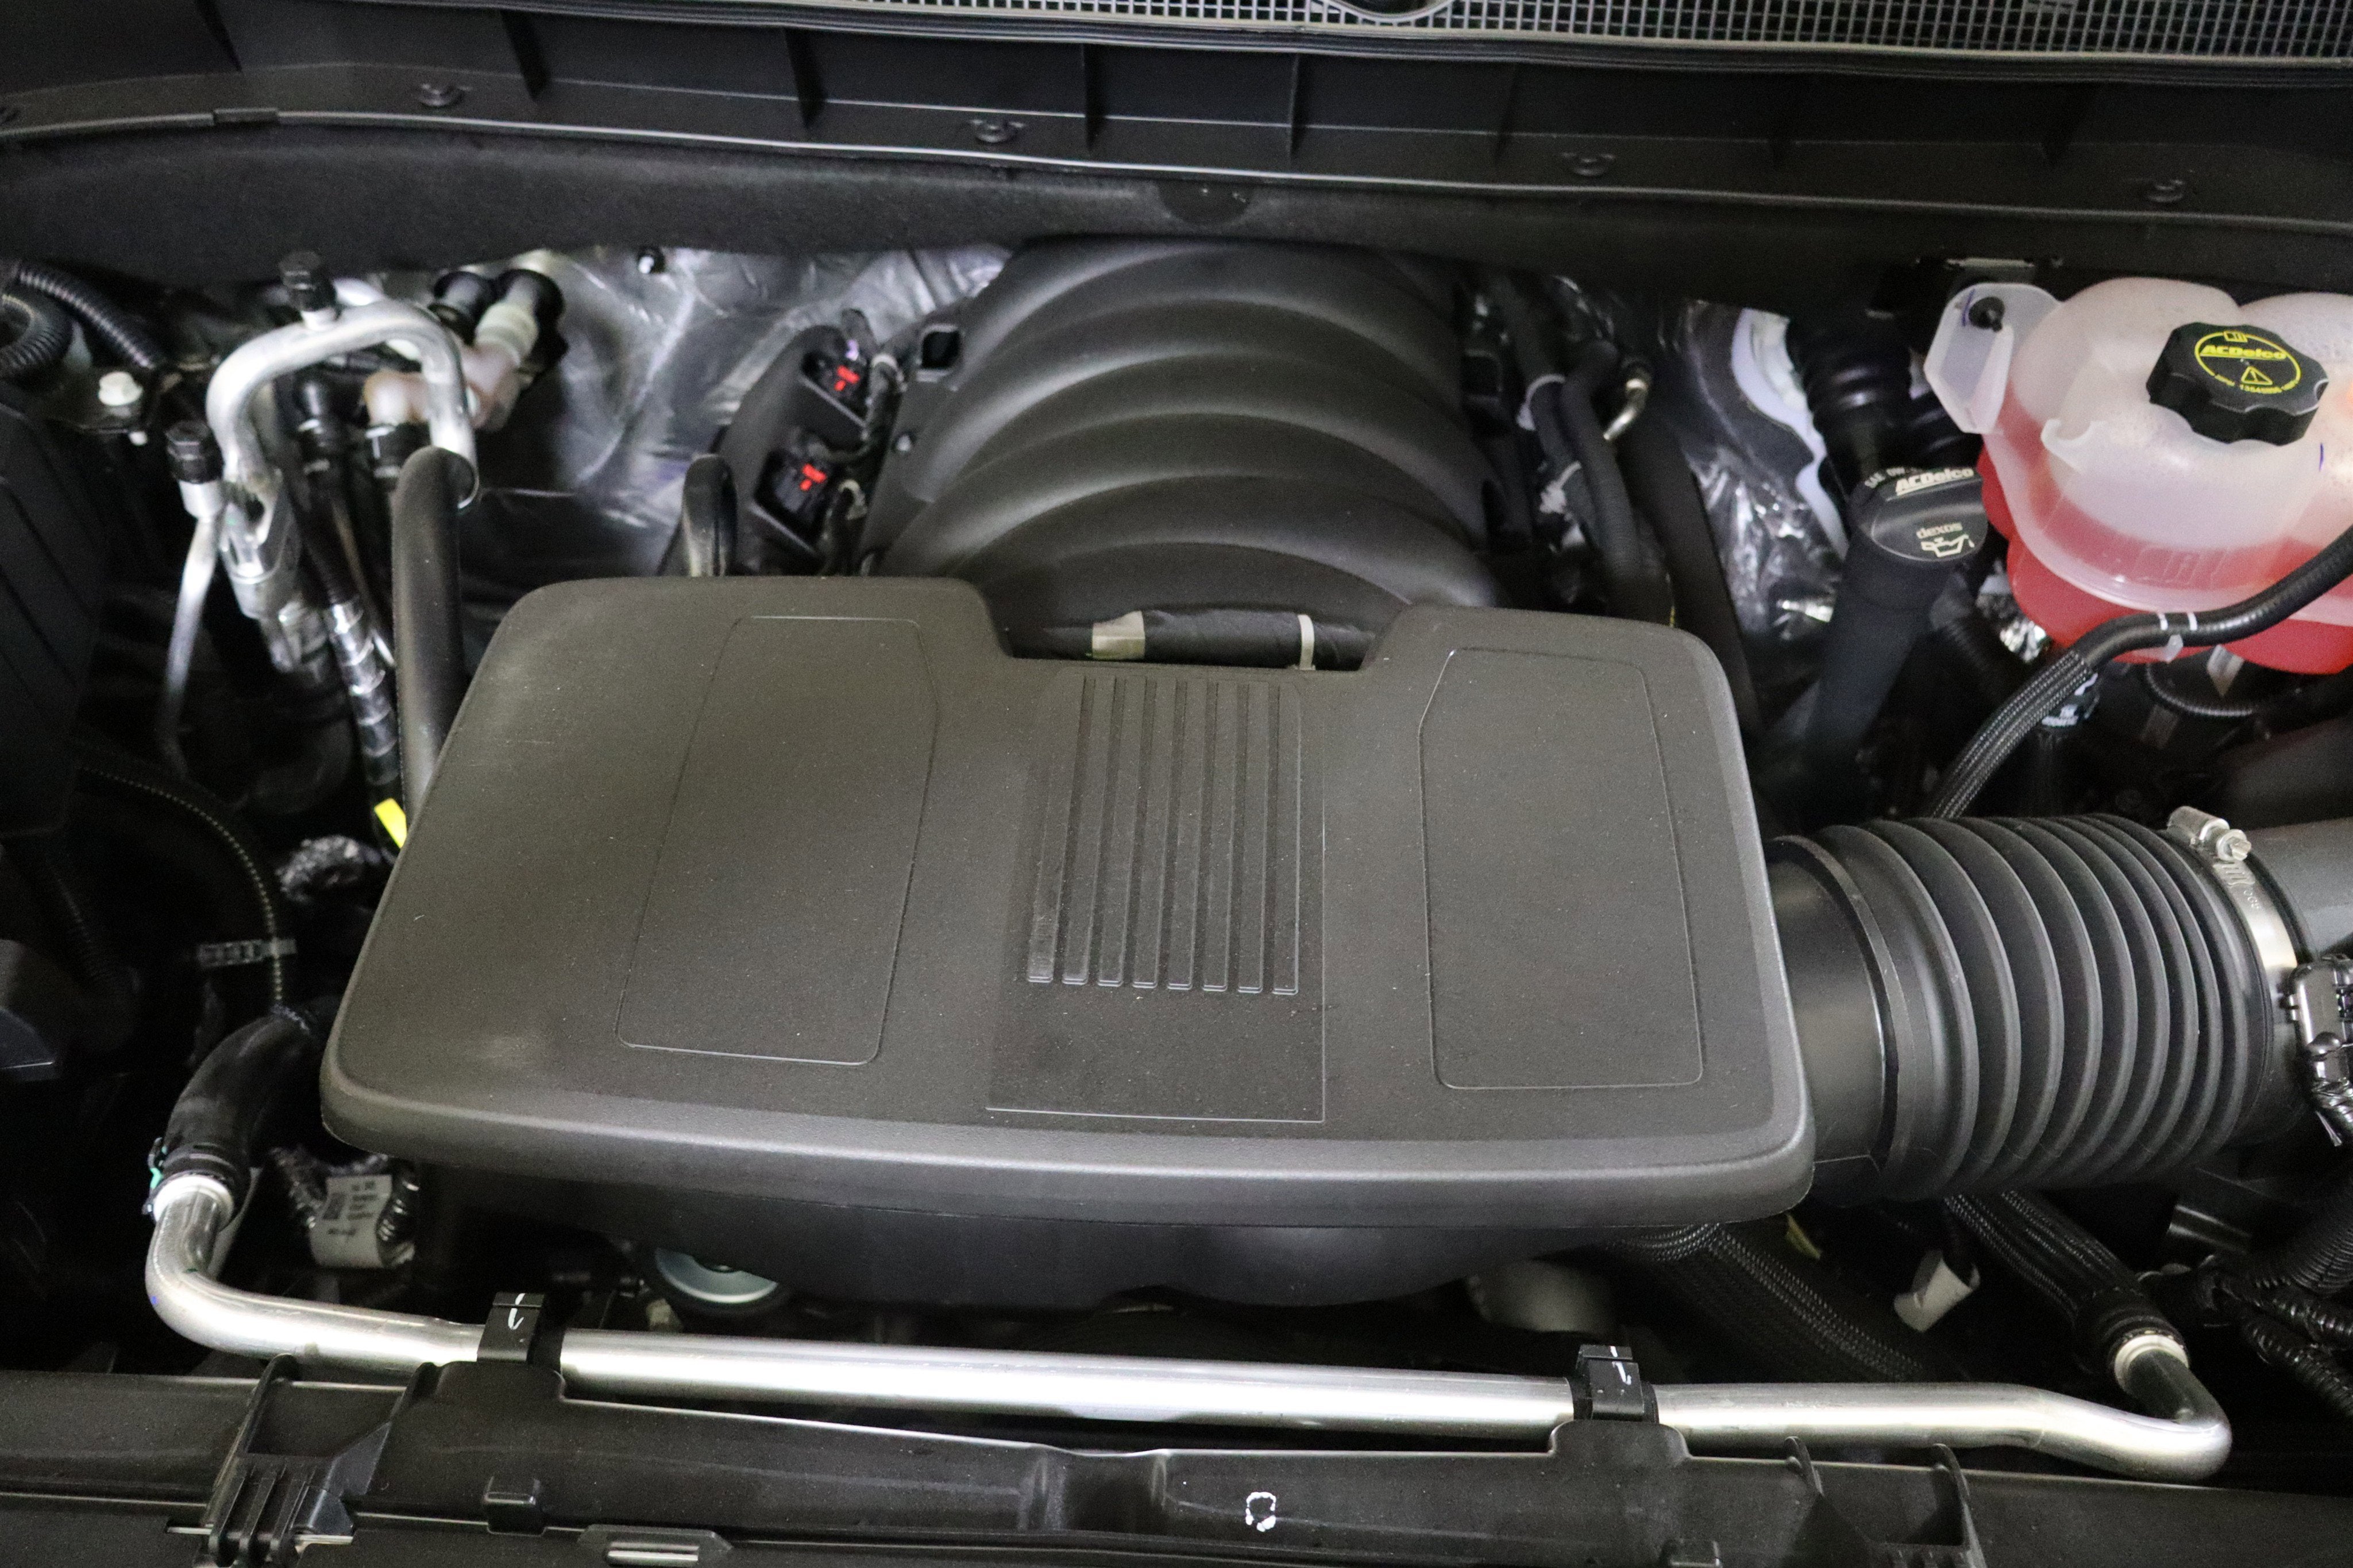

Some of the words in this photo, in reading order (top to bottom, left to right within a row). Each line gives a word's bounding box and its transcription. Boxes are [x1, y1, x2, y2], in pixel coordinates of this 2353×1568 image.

[2200, 345, 2288, 360] ACDelco
[1896, 468, 1974, 496] ACDelco
[1916, 523, 1963, 539] dexos
